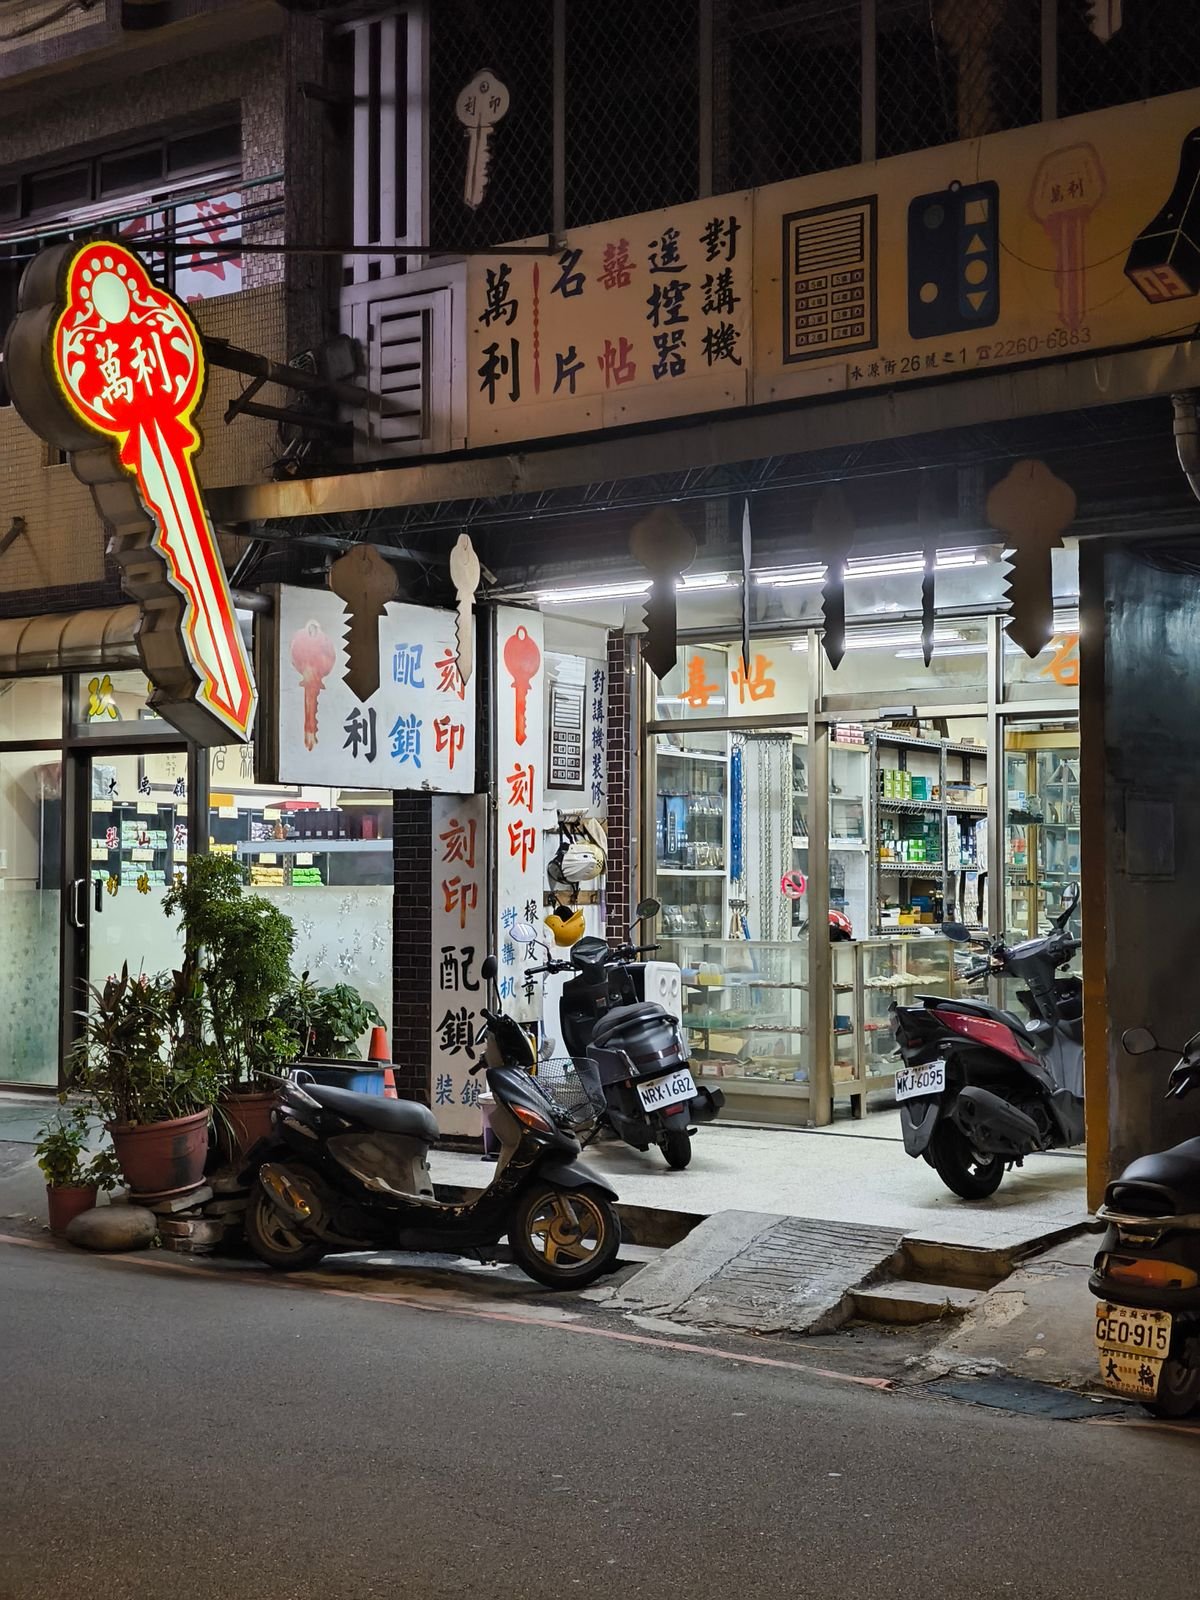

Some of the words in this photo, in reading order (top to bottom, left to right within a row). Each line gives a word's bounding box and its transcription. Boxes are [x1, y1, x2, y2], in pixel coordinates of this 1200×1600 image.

[464, 95, 502, 116] 刻印
[478, 262, 520, 405] 萬利
[551, 248, 587, 395] 名片
[596, 238, 638, 389] 囍帖
[699, 216, 743, 368] 對講機
[95, 331, 173, 405] 萬利
[388, 643, 425, 769] 配鎖
[433, 648, 466, 770] 刻印
[677, 654, 777, 709] 喜帖
[108, 776, 186, 798] 大禹嶺
[591, 668, 606, 808] 對講機裝修
[105, 824, 187, 849] 梨山茶
[506, 762, 536, 874] 刻印
[520, 898, 540, 1005] 橡皮章
[435, 1073, 482, 1110] 裝鎖
